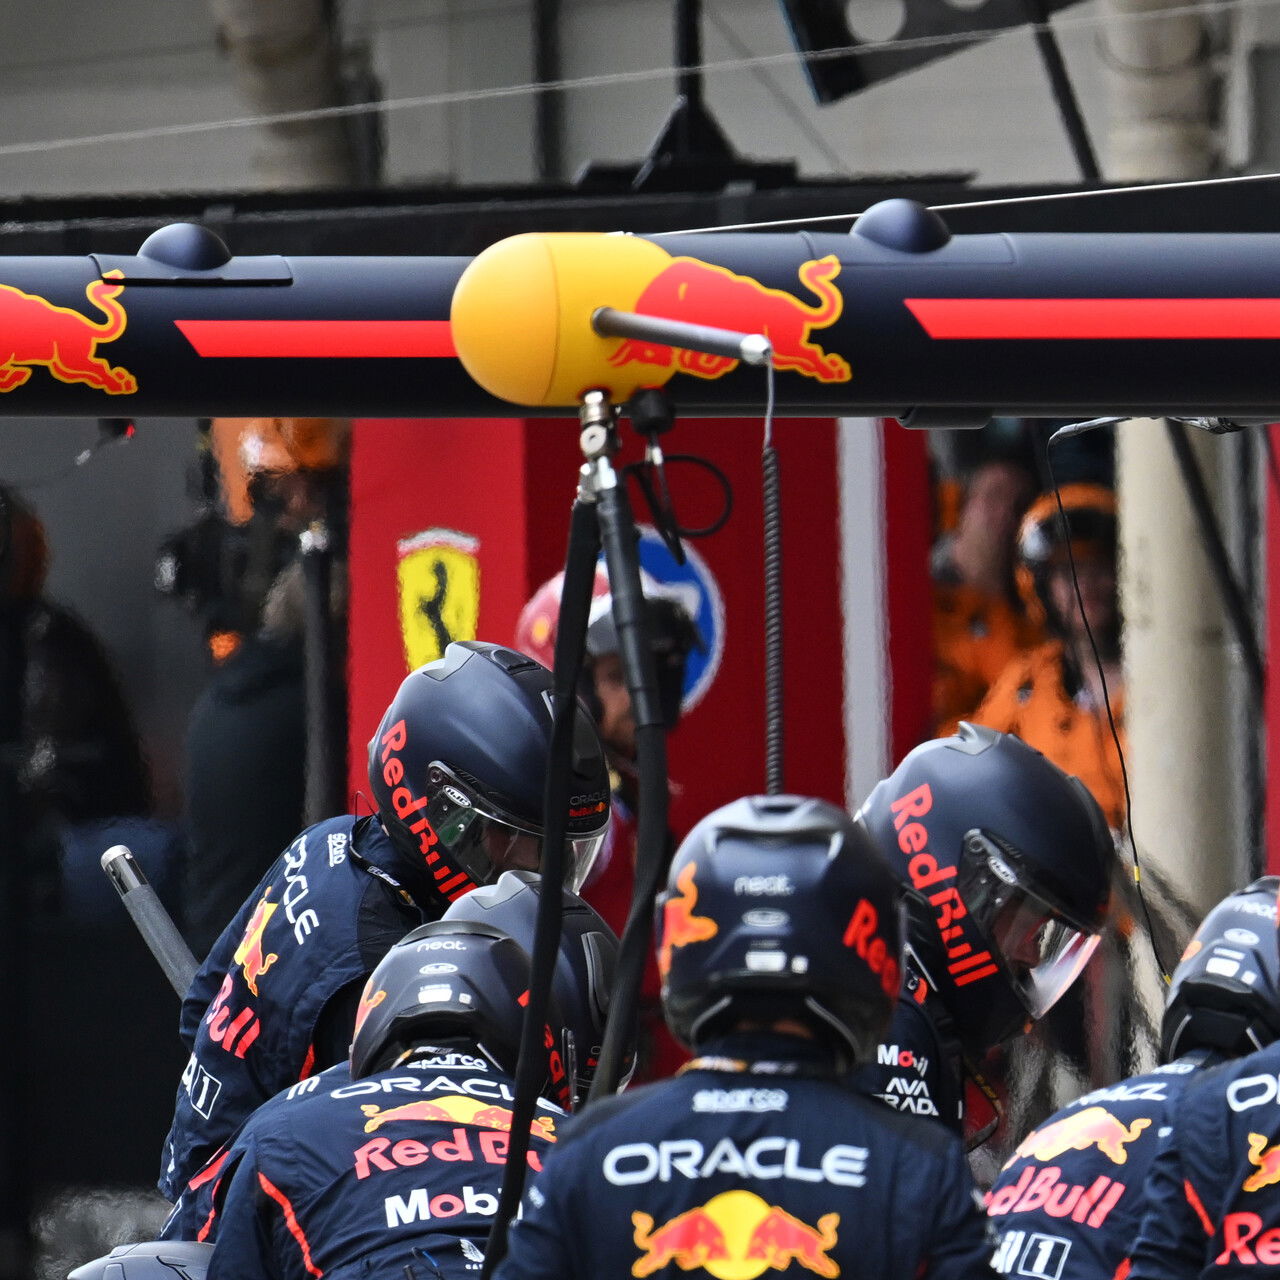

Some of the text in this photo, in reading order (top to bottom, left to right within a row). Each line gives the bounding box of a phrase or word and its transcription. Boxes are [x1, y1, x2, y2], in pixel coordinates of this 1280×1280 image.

[417, 940, 467, 952] neat.
[886, 1077, 929, 1097] AVA
[872, 1093, 939, 1116] RAD
[354, 1128, 474, 1180] Red
[603, 1136, 870, 1188] ORACLE
[385, 1186, 523, 1228] Mob
